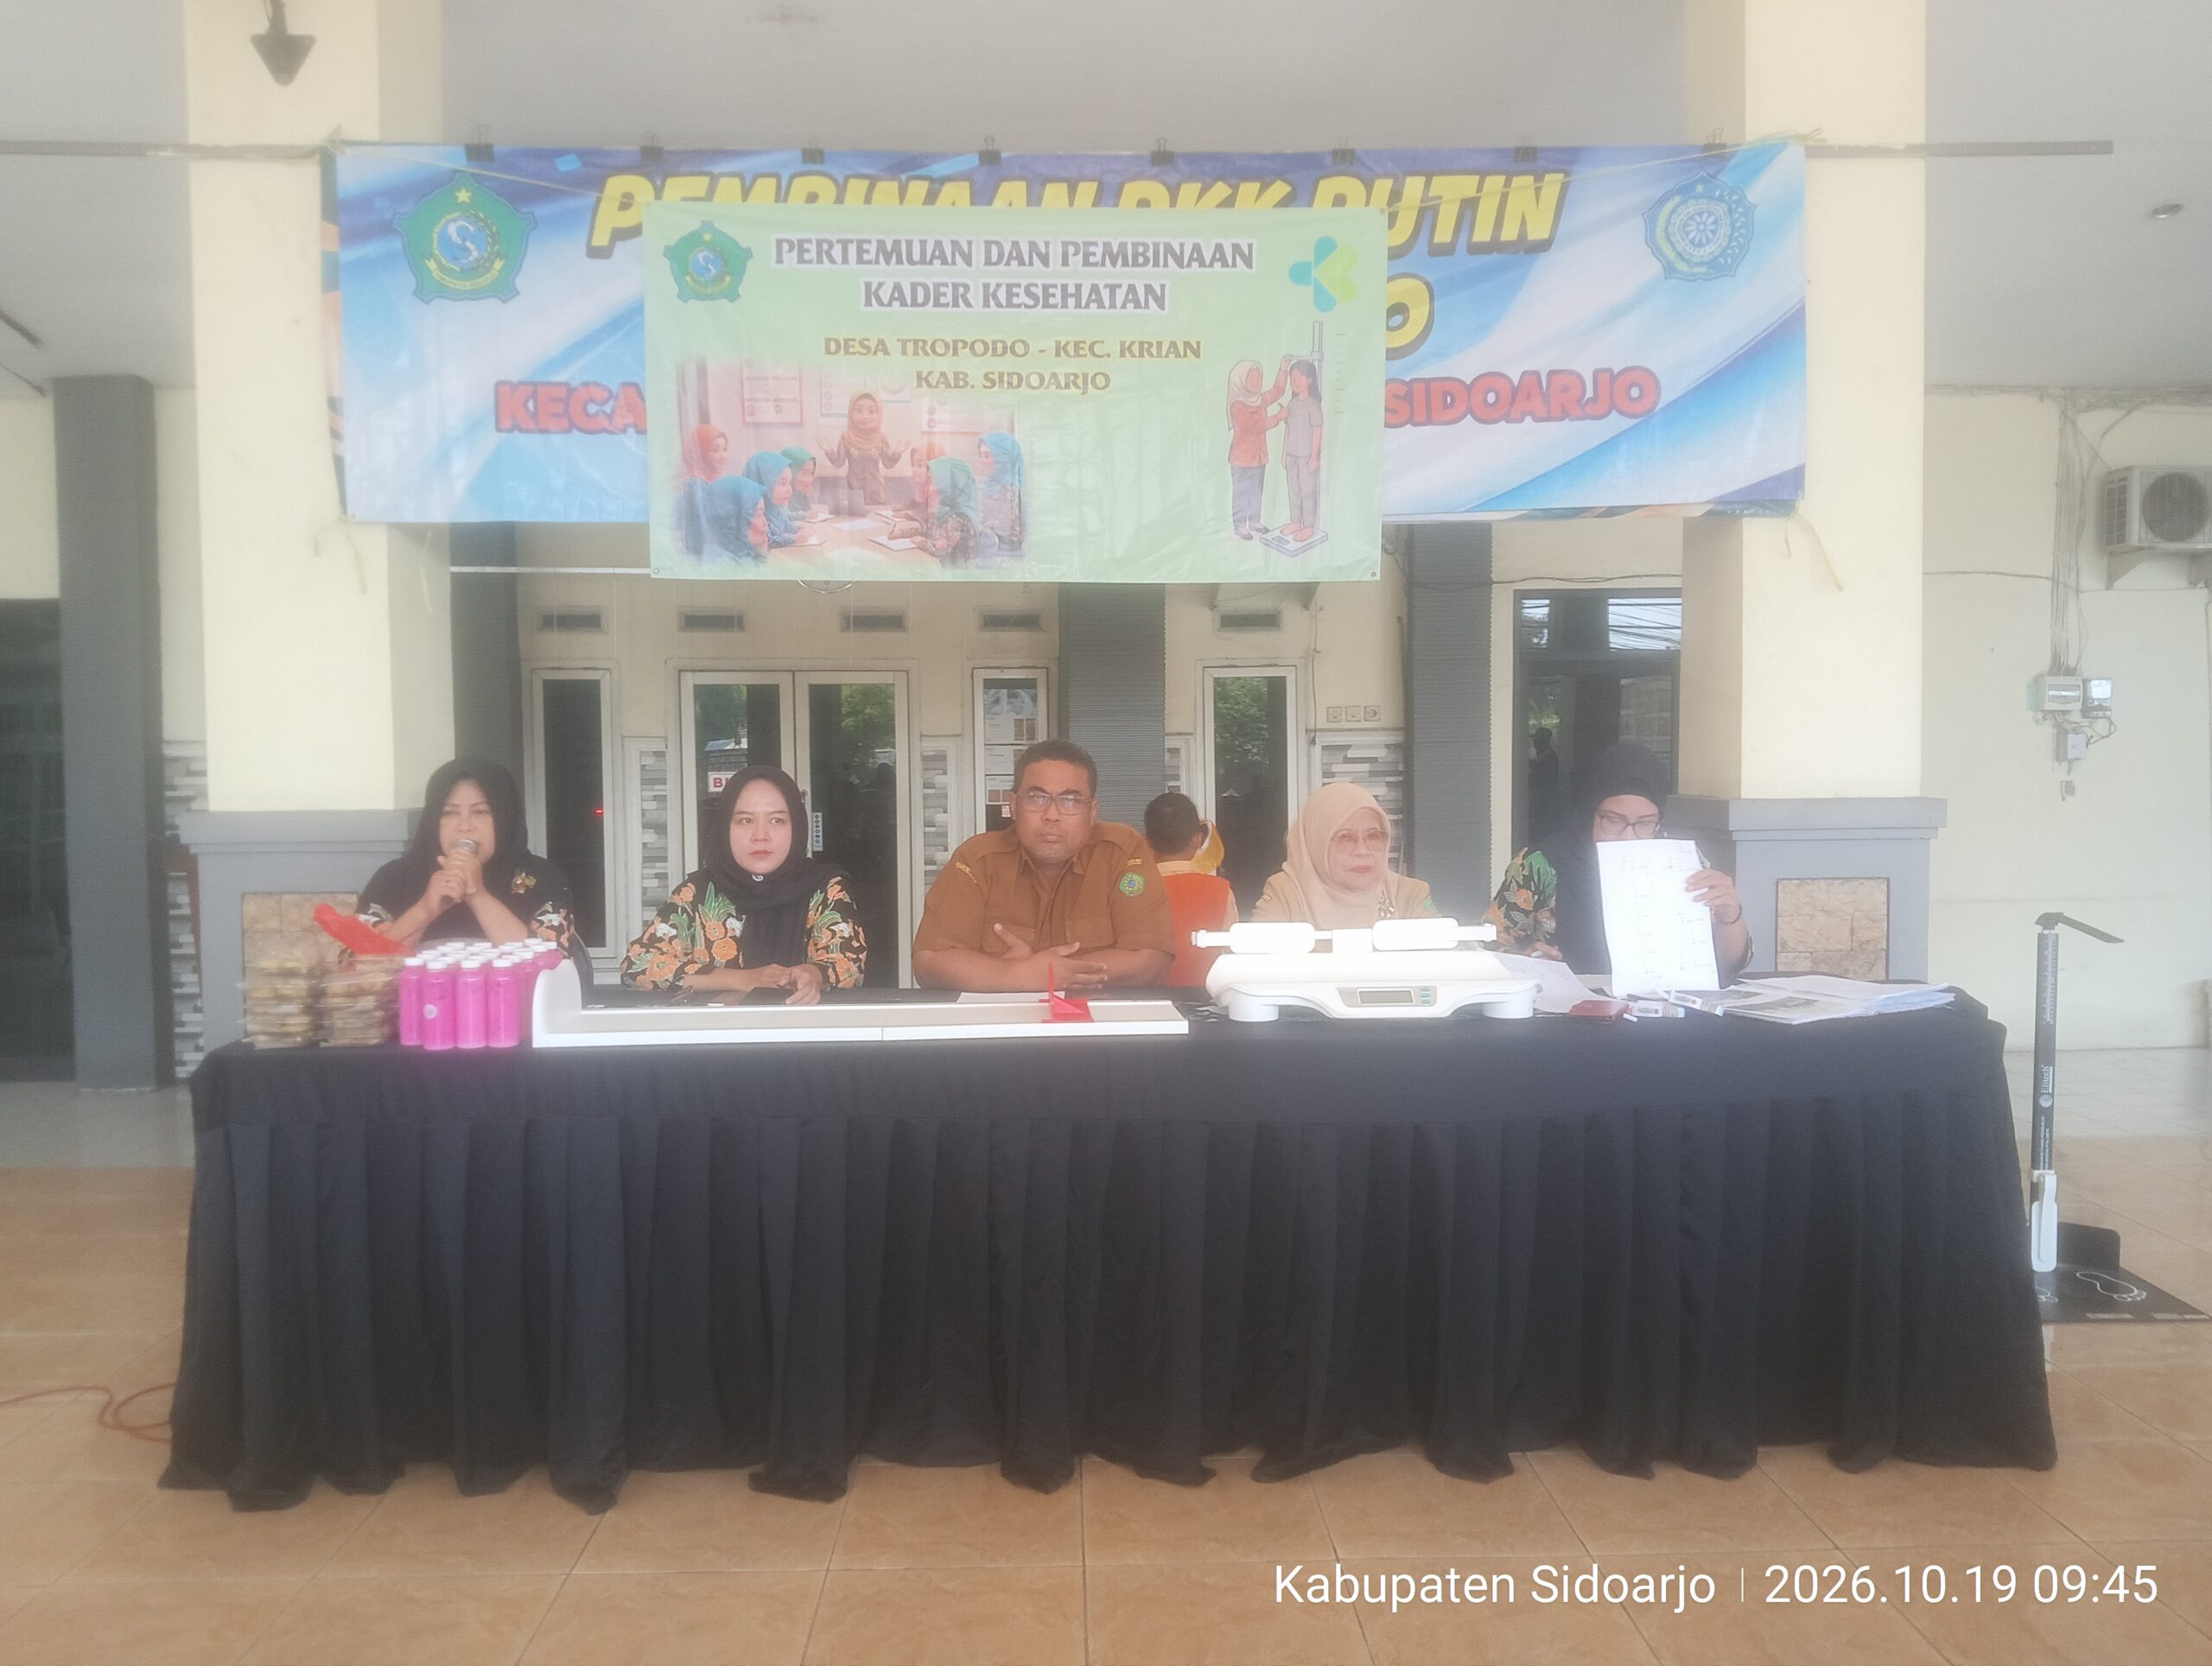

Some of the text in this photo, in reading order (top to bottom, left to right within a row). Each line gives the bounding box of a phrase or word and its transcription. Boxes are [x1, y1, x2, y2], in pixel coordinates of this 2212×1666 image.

[774, 237, 1255, 270] PERTEMUAN DAN PEMBINAAN
[863, 281, 1167, 310] KADER KESEHATAN
[823, 338, 891, 356] DESA
[897, 338, 1030, 358] TROPODO
[1053, 340, 1111, 359] KEC.
[1118, 340, 1202, 359] KRIAN
[915, 371, 1112, 396] KAB. SIDOARJO
[1384, 366, 1661, 428] SIDOARJO
